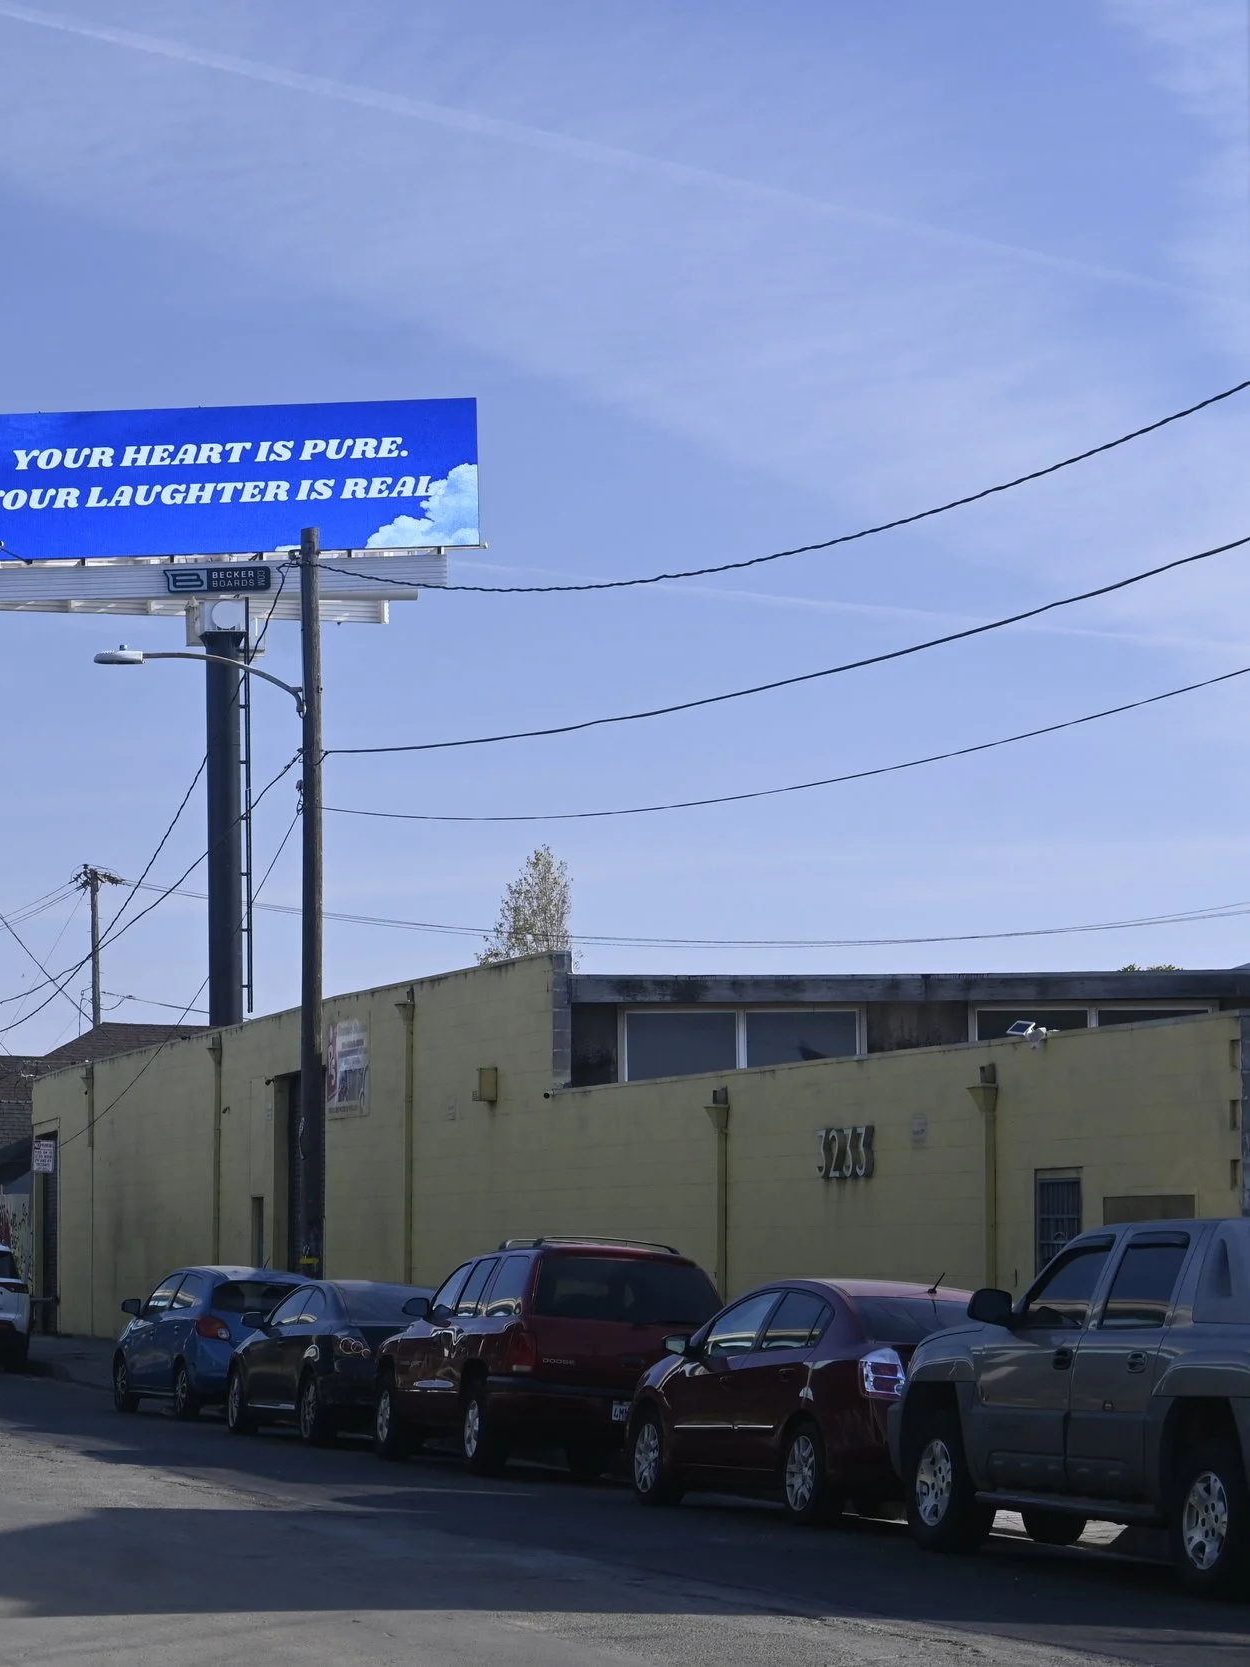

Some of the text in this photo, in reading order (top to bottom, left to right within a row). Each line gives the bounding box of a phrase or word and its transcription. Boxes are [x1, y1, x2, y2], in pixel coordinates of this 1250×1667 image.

[13, 436, 409, 471] YOUR HEART IS PURE.
[85, 480, 291, 508] LAUGHTER
[295, 479, 335, 501] IS
[212, 570, 254, 579] BECKER
[212, 579, 254, 588] BOARDS
[815, 1126, 869, 1178] 3233
[542, 1357, 575, 1366] DODGE
